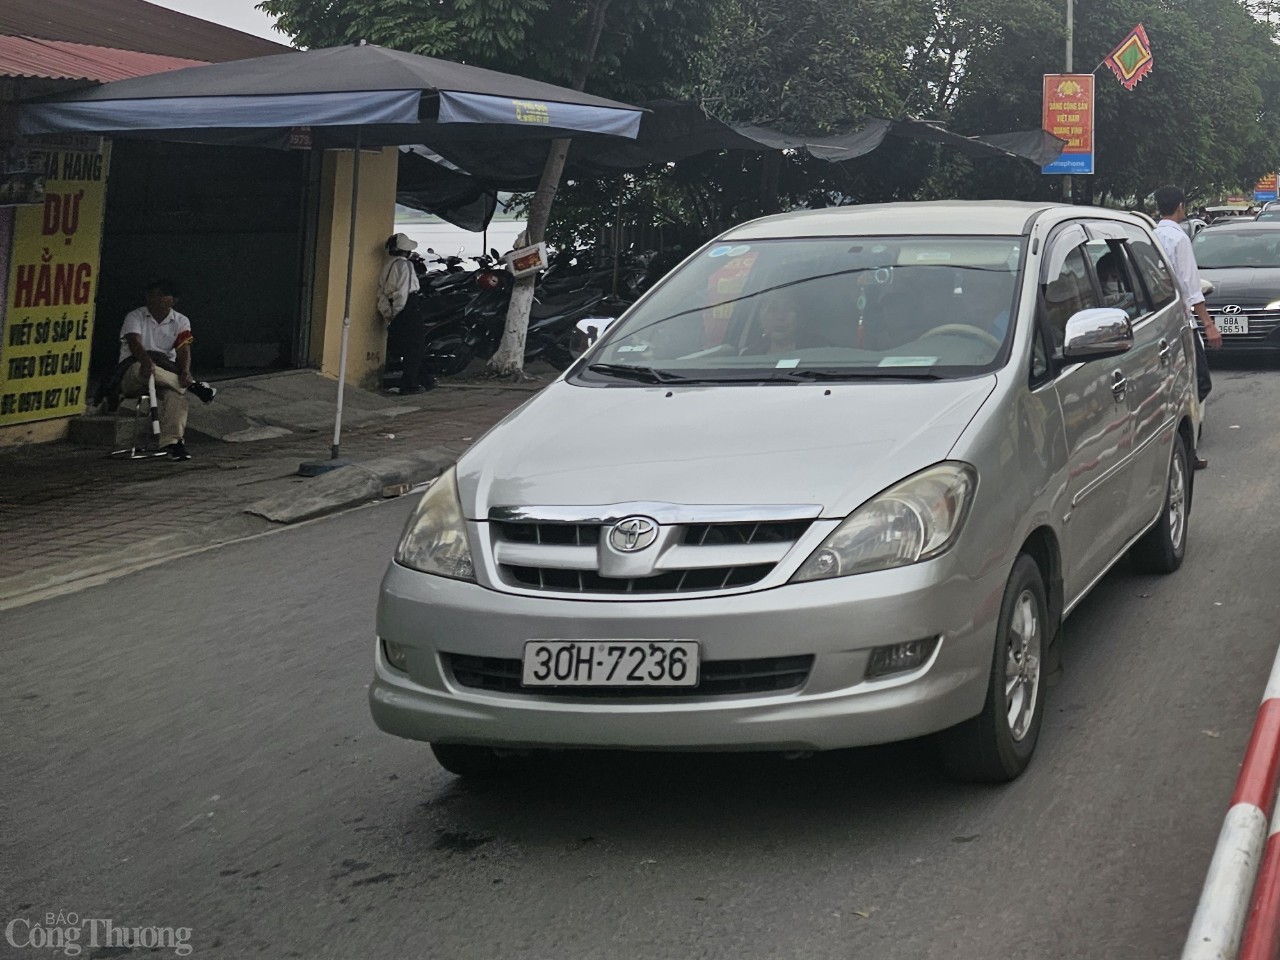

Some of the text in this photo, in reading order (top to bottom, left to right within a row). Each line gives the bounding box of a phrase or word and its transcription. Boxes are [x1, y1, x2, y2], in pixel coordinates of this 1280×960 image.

[42, 189, 85, 245] DỰ
[1224, 317, 1239, 325] 88A
[8, 356, 36, 380] THEO
[39, 350, 59, 377] YÊU
[64, 385, 81, 407] 147
